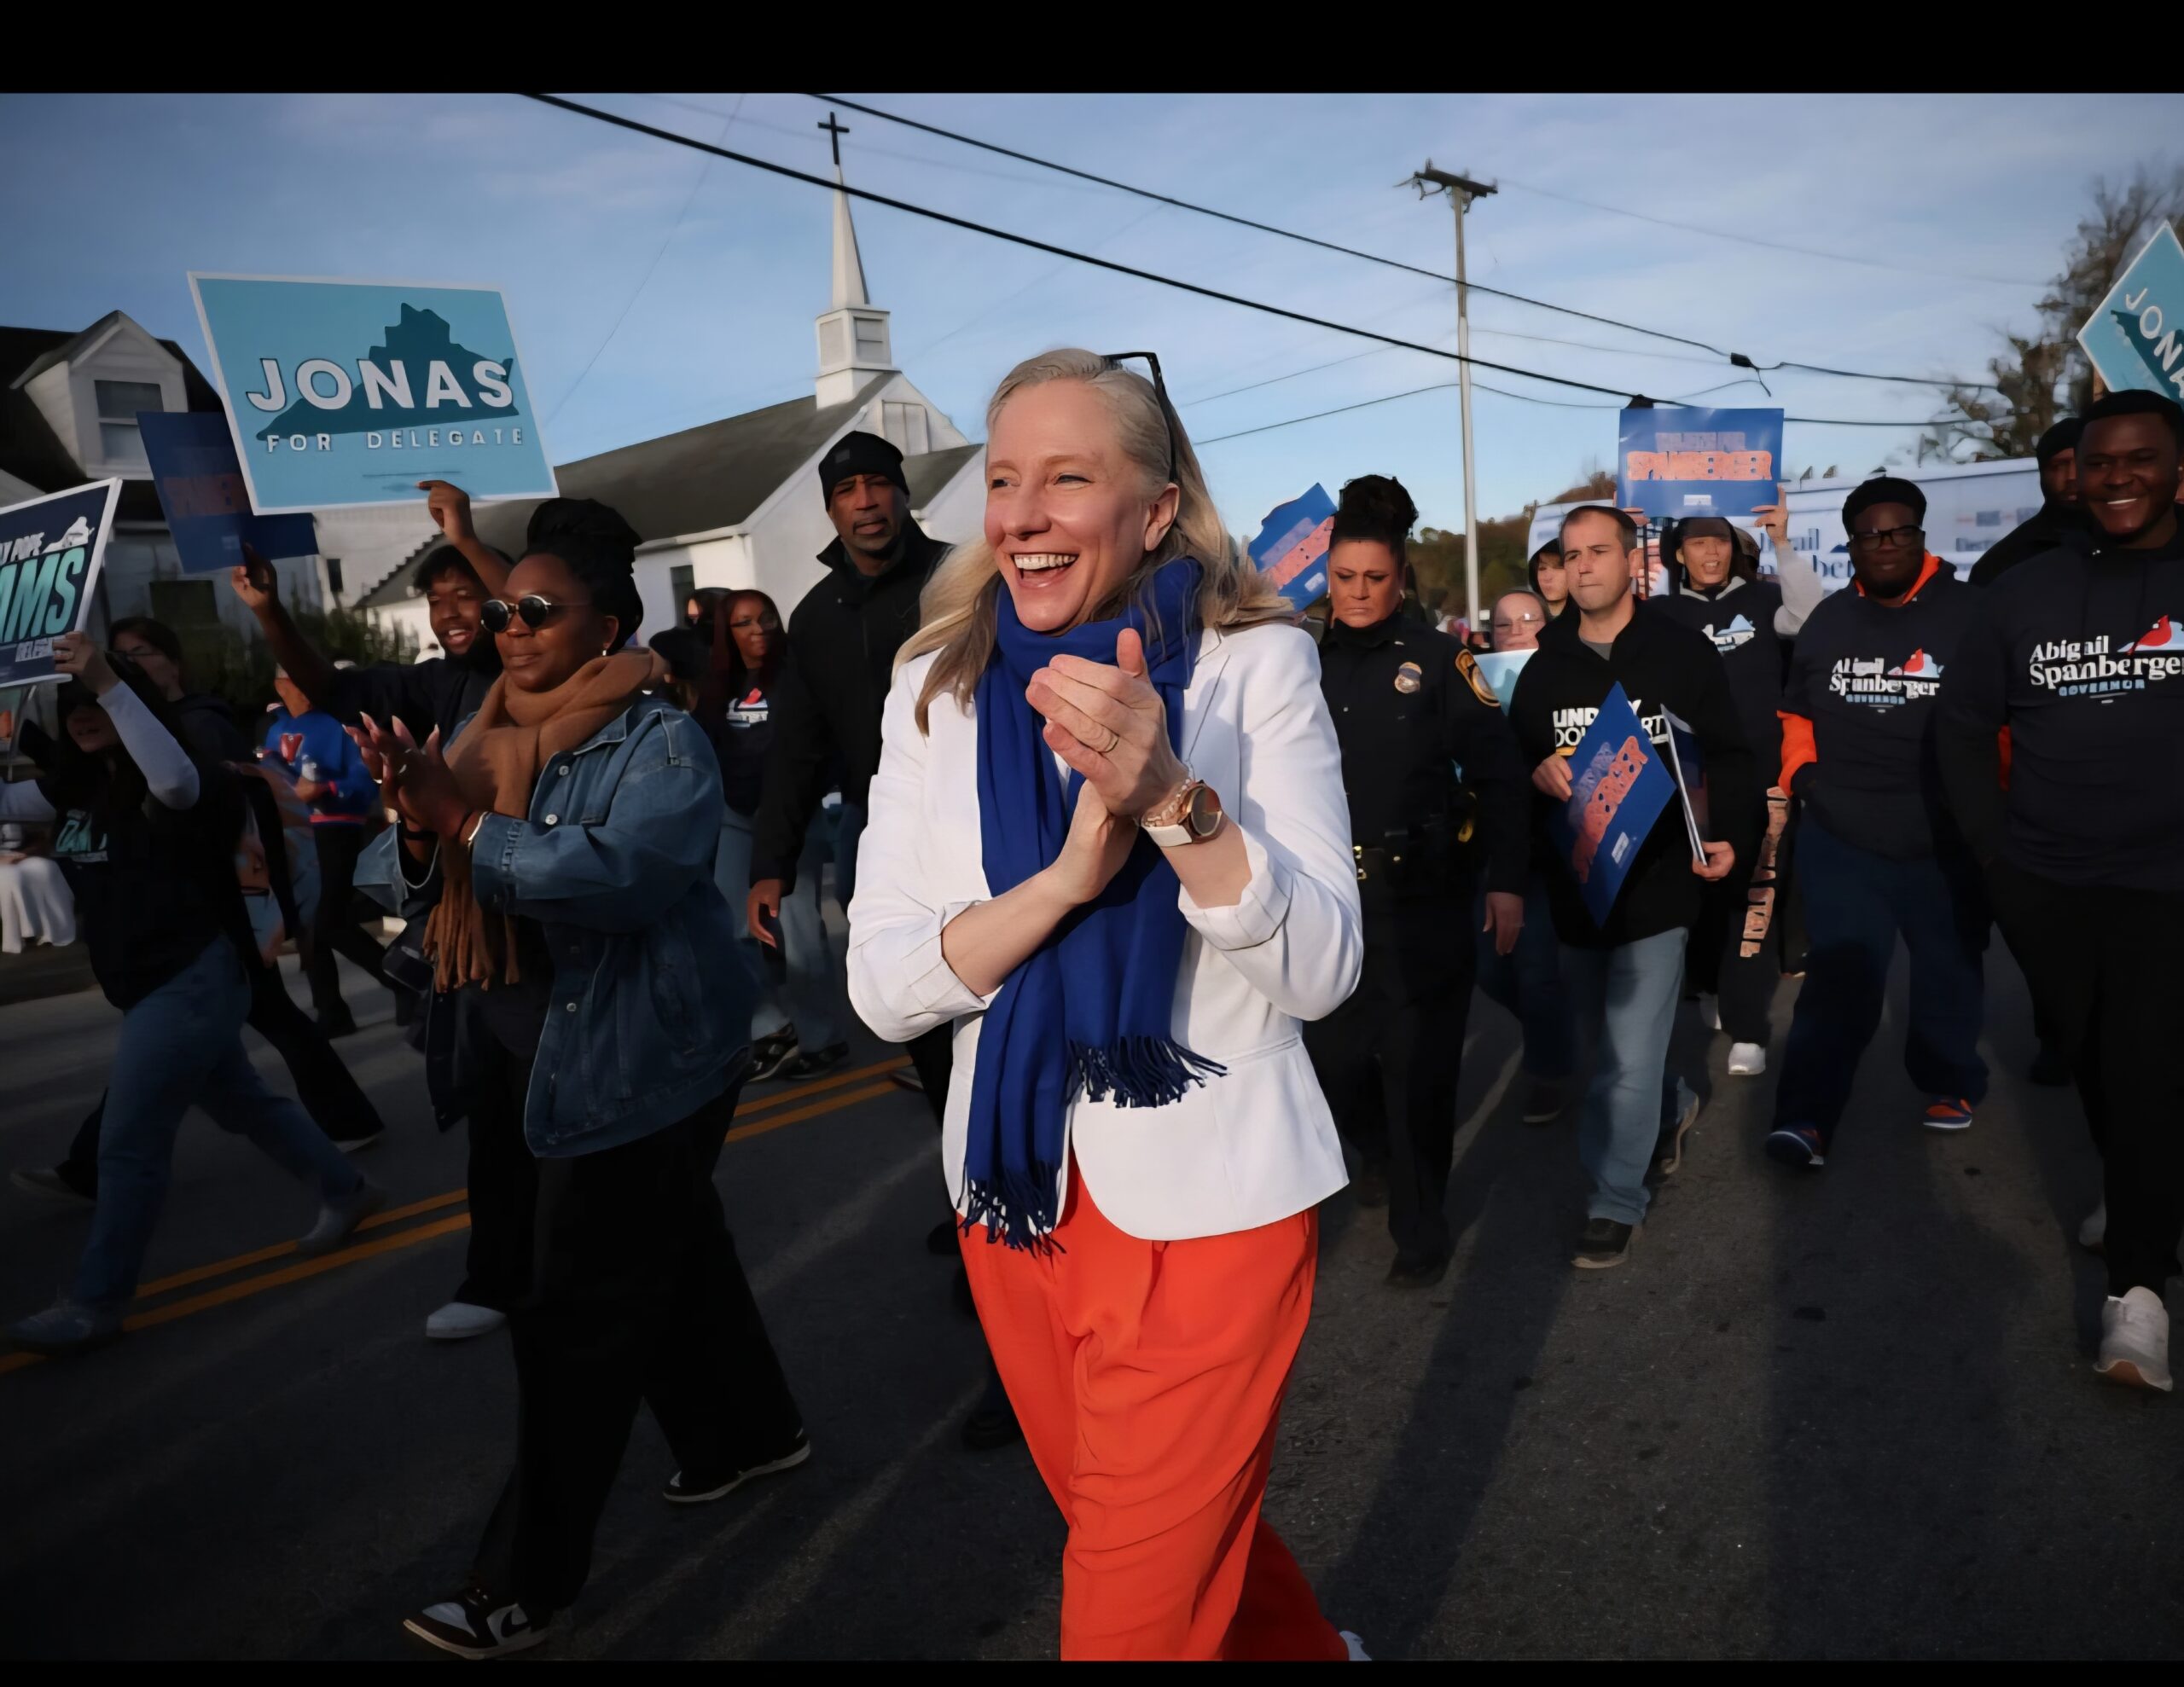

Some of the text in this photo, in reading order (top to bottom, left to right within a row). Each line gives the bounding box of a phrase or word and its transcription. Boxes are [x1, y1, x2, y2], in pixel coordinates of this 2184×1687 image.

[246, 358, 513, 412] JONAS
[266, 428, 523, 453] FOR DELEGATE
[2030, 635, 2109, 664] Abigail
[2030, 654, 2184, 689] Spanberge
